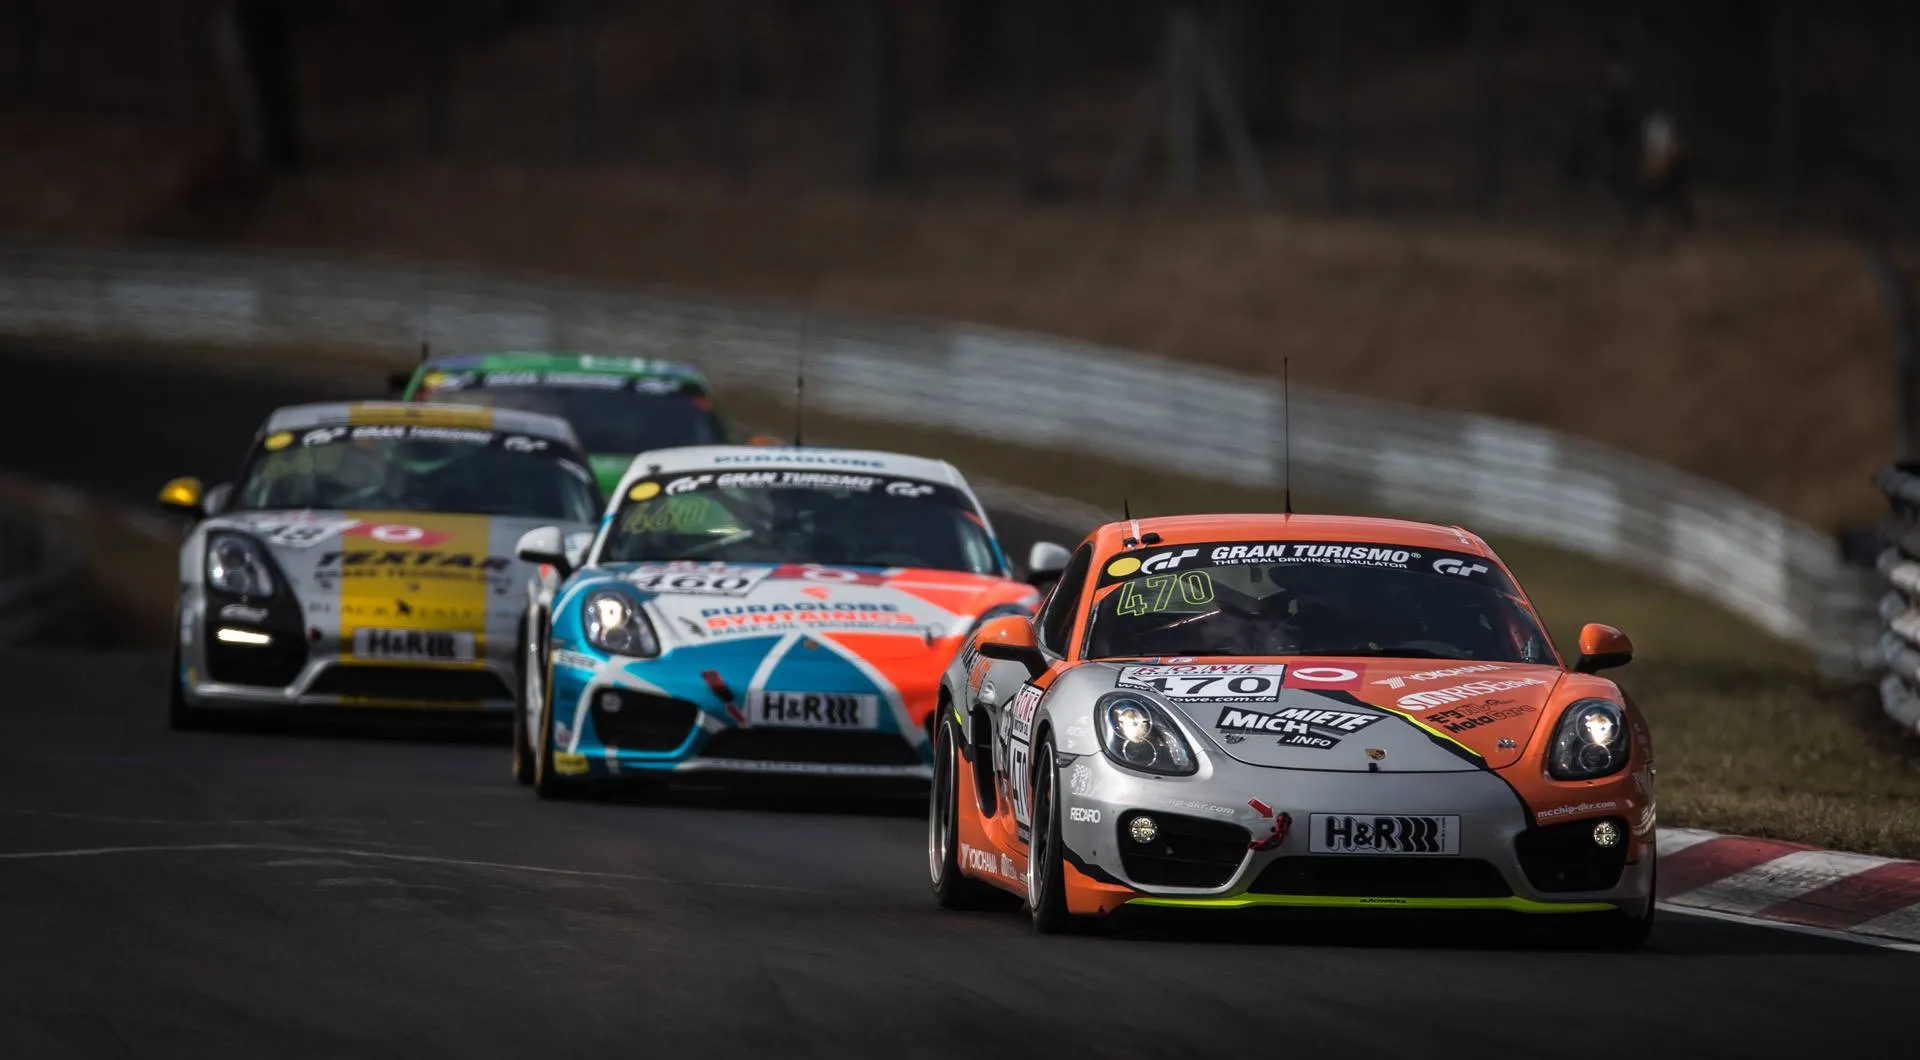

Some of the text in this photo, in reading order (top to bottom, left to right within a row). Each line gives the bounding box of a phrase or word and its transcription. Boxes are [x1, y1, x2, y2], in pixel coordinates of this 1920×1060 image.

[714, 455, 884, 468] PURAGLOBE
[717, 472, 778, 487] GRAN
[318, 550, 511, 570] TEXTAR
[1211, 545, 1285, 560] GRAN
[1333, 559, 1408, 569] SIMULATOR
[1117, 571, 1214, 616] 470
[701, 601, 897, 618] PURAGLOBE
[707, 610, 916, 628] SYNTAINICS
[711, 624, 763, 636] BASE
[1128, 676, 1271, 695] 470
[1221, 710, 1308, 734] MICH
[1275, 708, 1378, 730] MIETE
[1070, 807, 1101, 823] RECARO
[1537, 800, 1616, 819] mcchip-dkr.com
[1326, 816, 1404, 852] H&R
